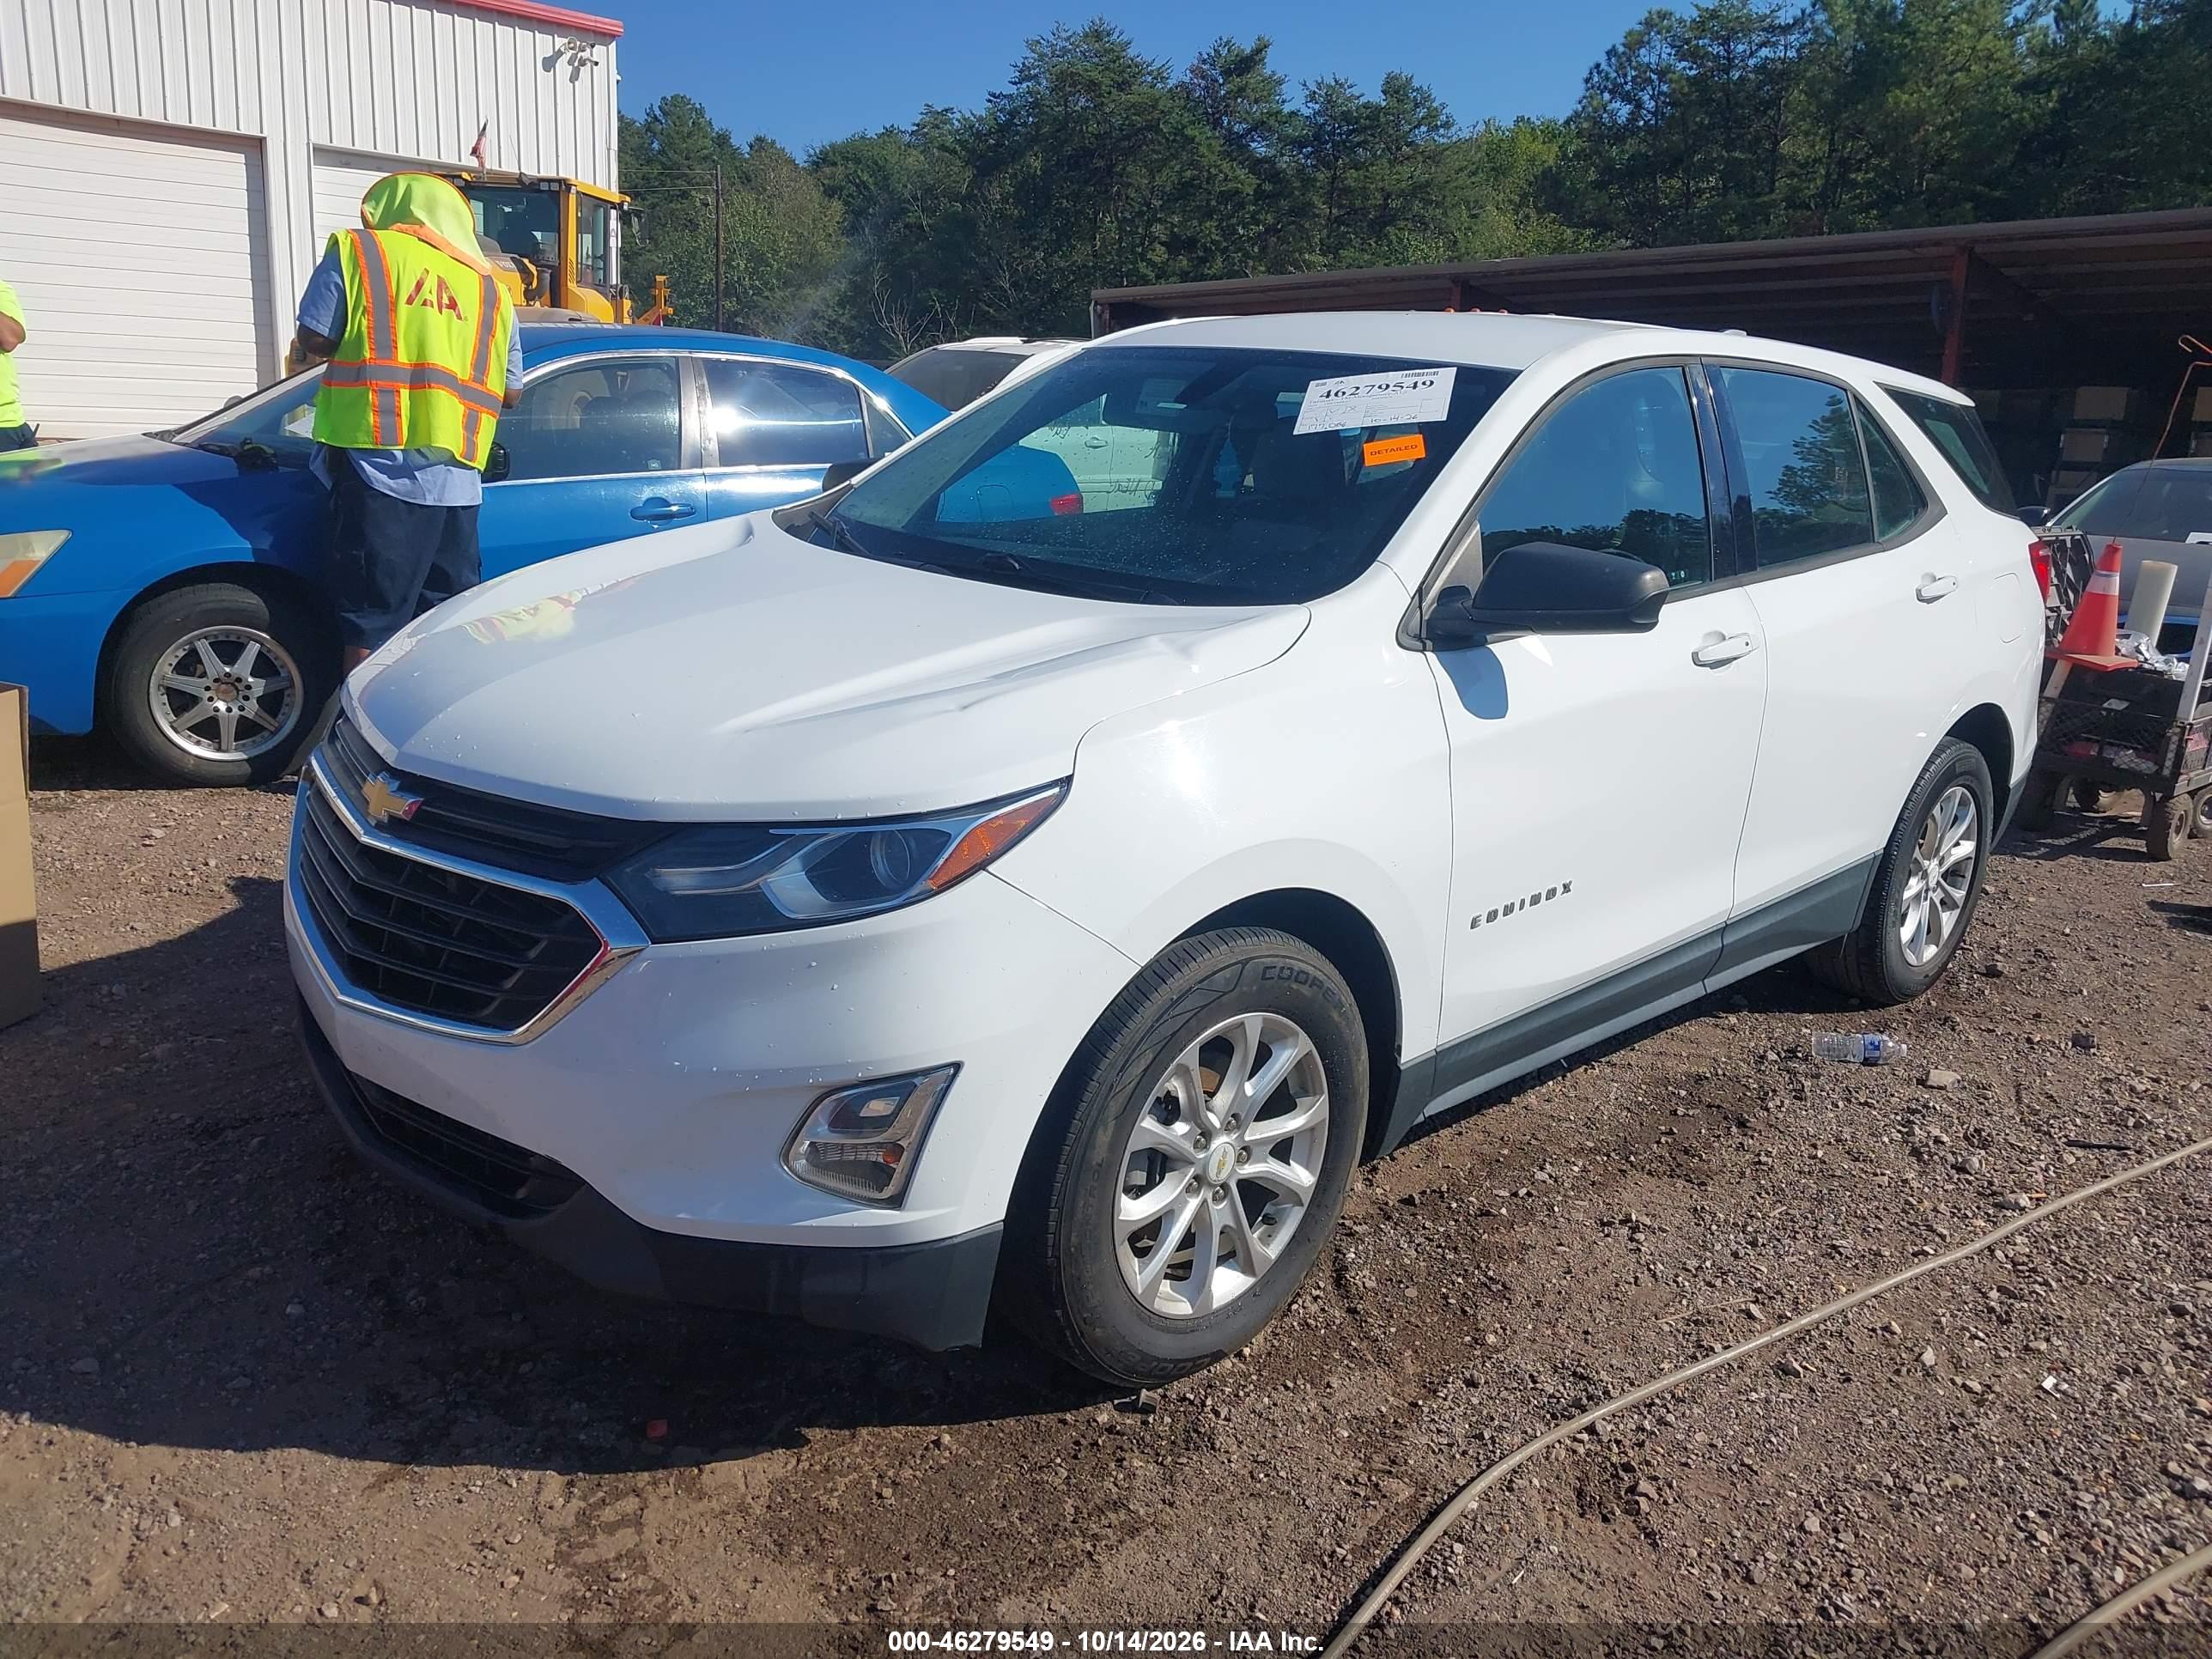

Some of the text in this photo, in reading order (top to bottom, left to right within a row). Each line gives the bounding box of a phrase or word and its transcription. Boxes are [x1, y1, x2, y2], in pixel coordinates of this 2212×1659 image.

[1318, 379, 1435, 400] 46279549
[1370, 444, 1418, 457] DETAILED
[1469, 879, 1573, 930] EQUINOX
[1260, 964, 1346, 1012] COOPE
